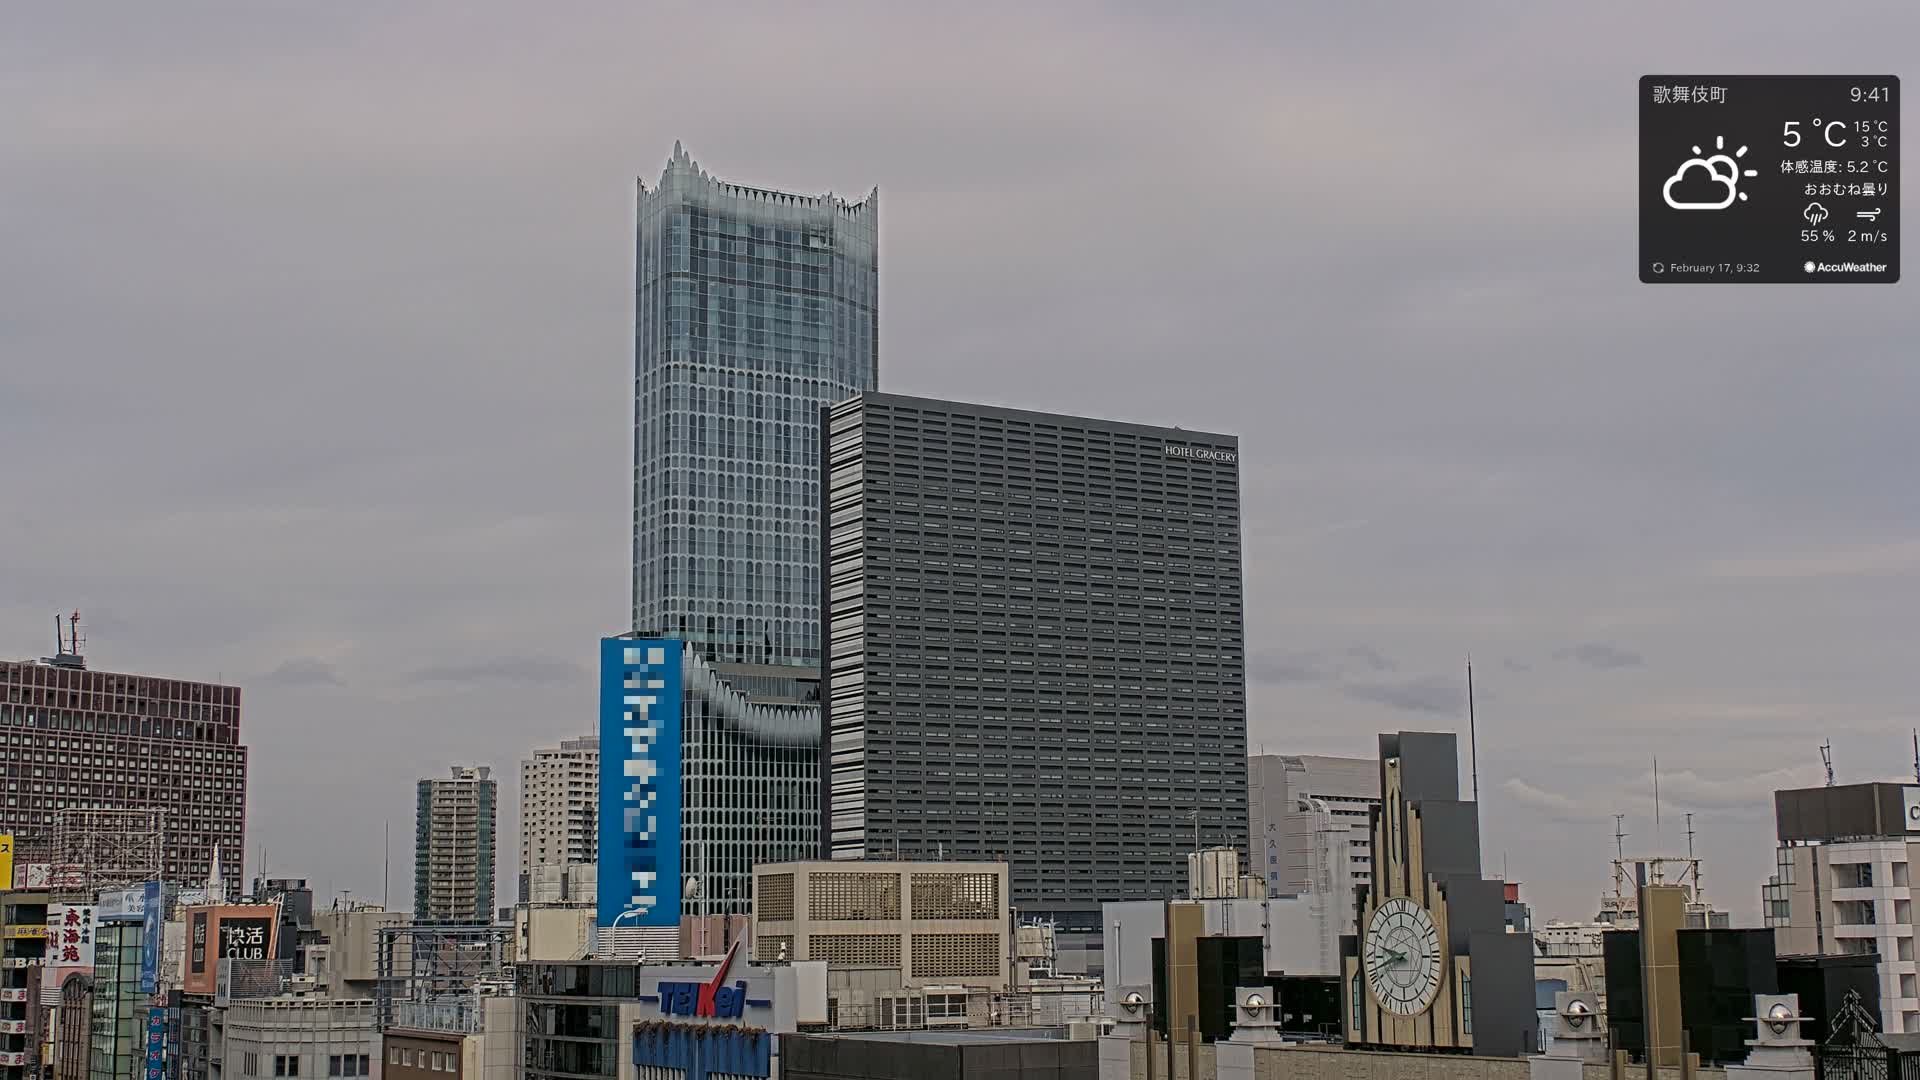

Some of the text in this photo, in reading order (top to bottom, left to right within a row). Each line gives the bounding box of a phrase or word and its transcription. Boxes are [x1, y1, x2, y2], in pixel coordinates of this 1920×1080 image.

[1165, 445, 1237, 462] HOTEL GRACERY
[61, 907, 81, 962] 東海苑
[228, 926, 264, 945] 快活
[227, 947, 263, 960] CLUB
[149, 1015, 161, 1079] カラオケ
